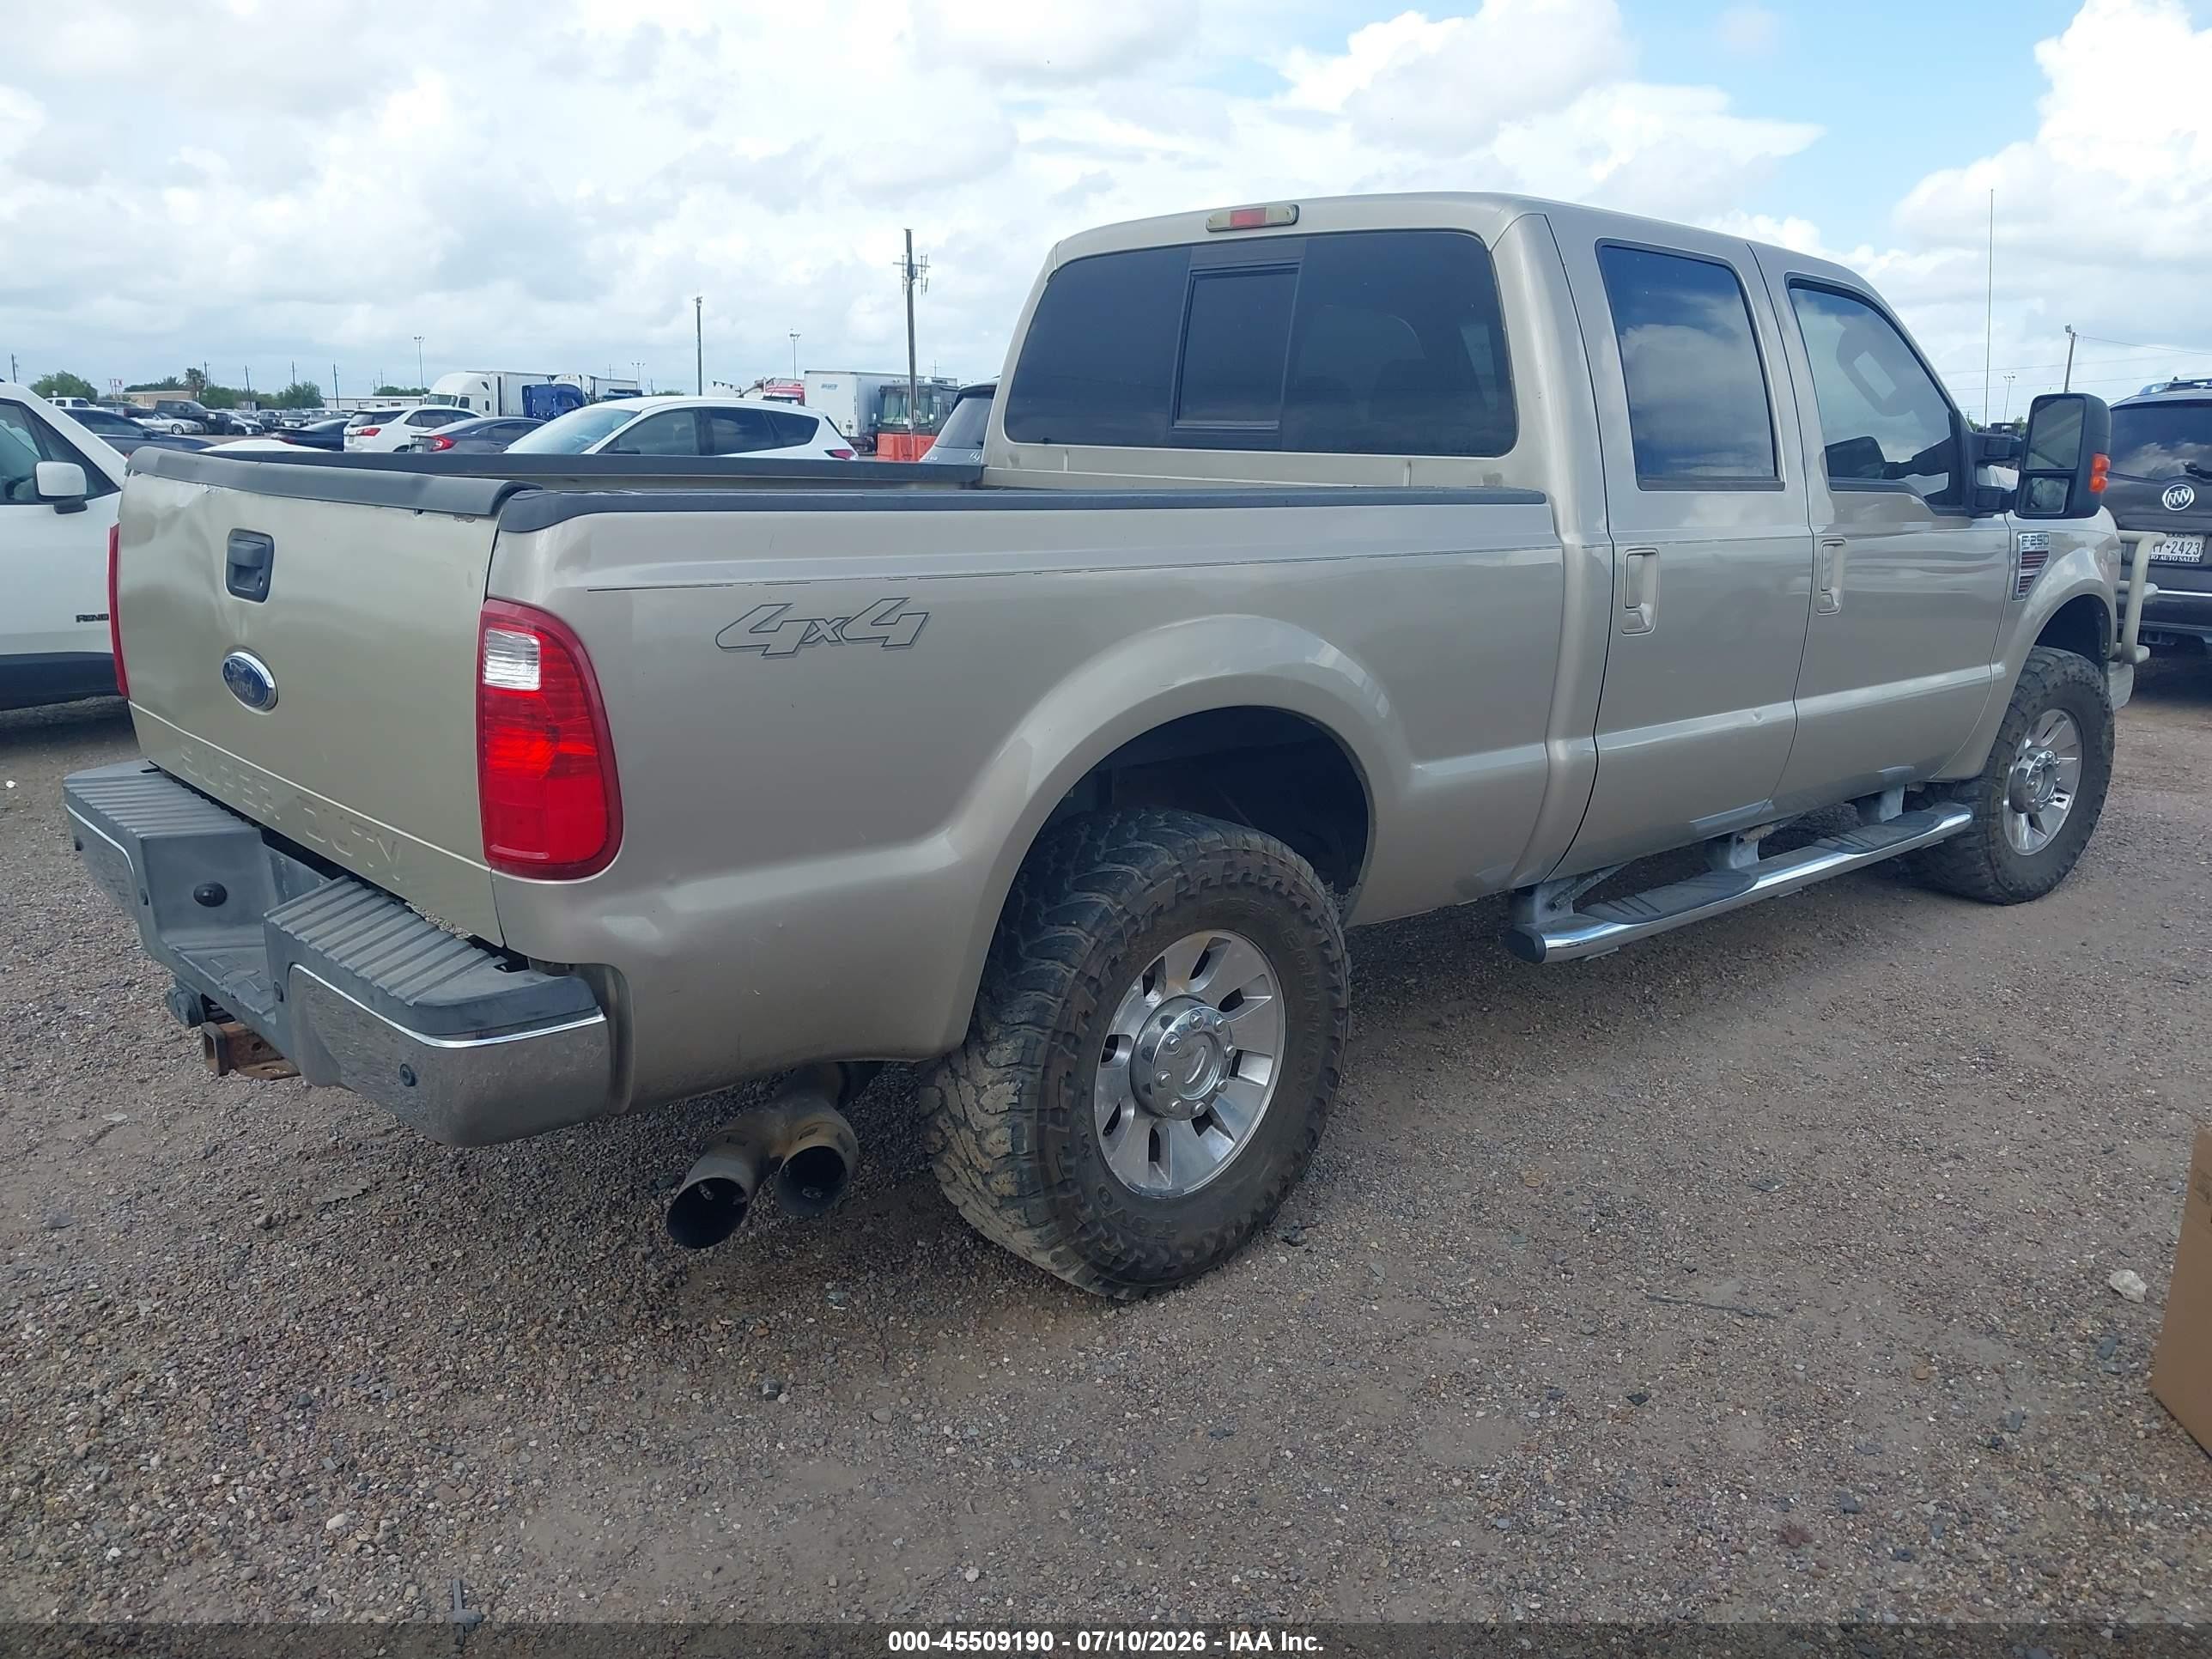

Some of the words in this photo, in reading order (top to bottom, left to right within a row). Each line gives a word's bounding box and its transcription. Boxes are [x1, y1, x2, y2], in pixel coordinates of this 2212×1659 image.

[715, 597, 931, 659] 4x4
[179, 744, 282, 822] SUPER
[295, 795, 403, 883] DUTY
[1097, 1182, 1177, 1240] TOYO
